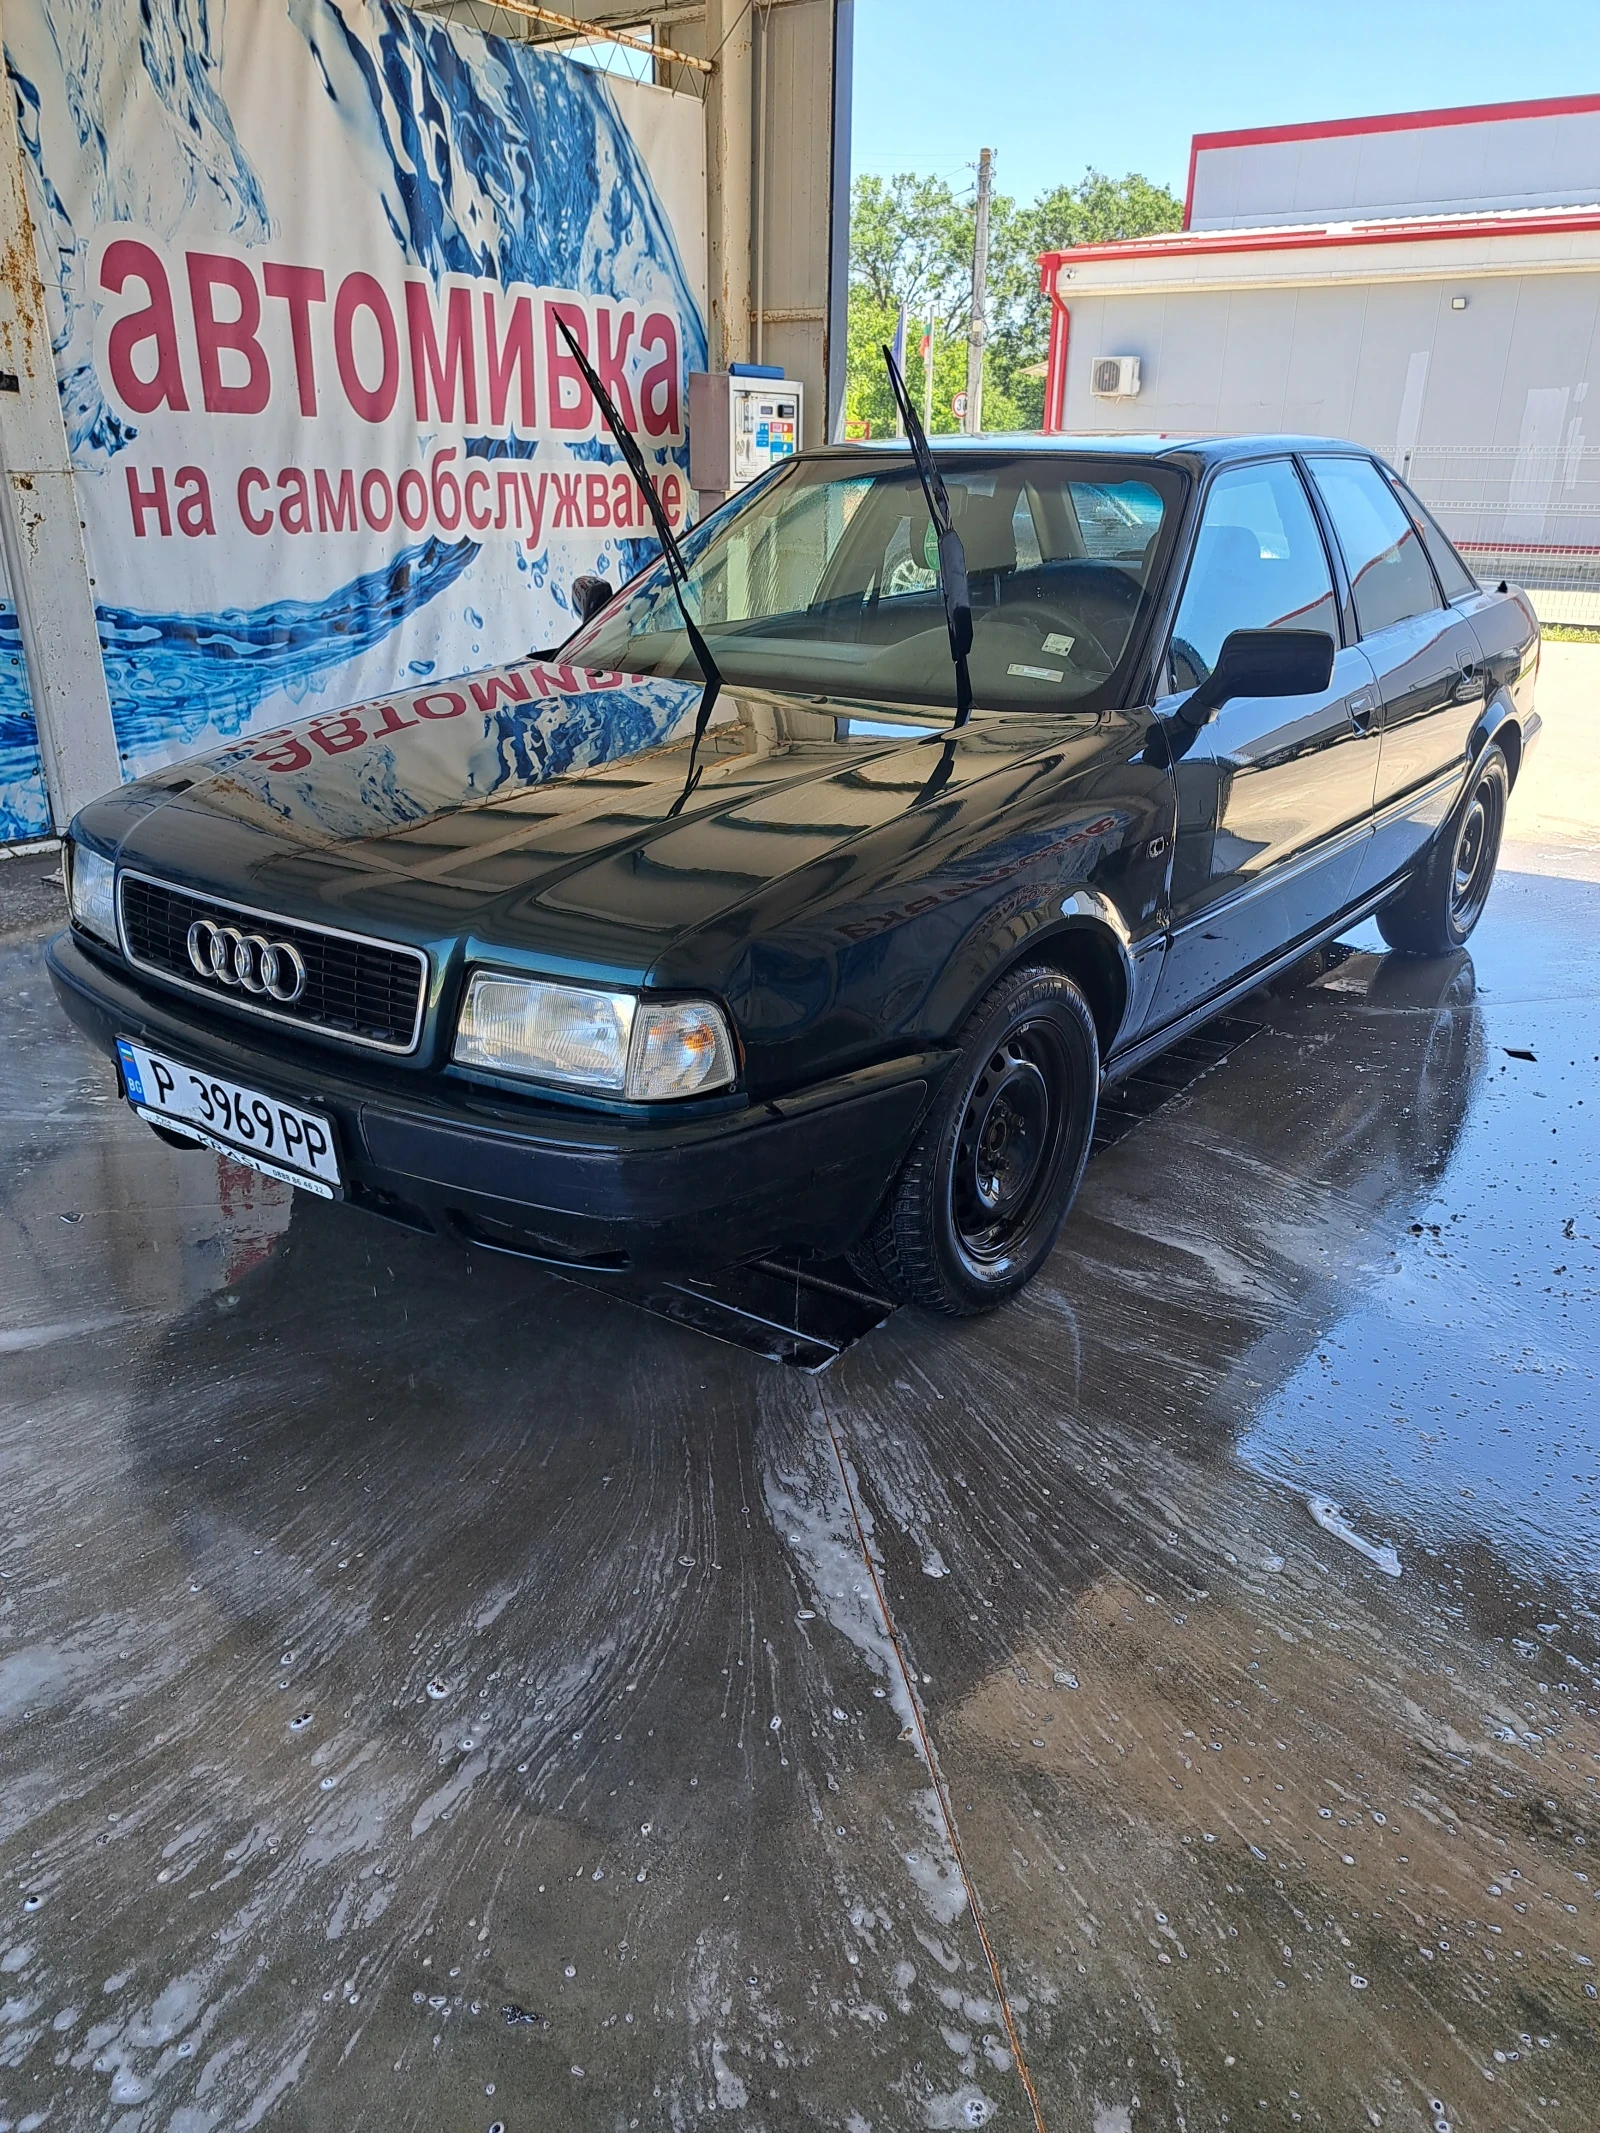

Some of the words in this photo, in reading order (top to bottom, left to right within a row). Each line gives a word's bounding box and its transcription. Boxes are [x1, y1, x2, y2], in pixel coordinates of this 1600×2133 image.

[100, 239, 681, 437] автомивка
[125, 465, 217, 538] на
[237, 446, 682, 550] самообслужване
[127, 1077, 143, 1094] BG
[148, 1059, 175, 1104] P
[189, 1075, 273, 1148] 3969
